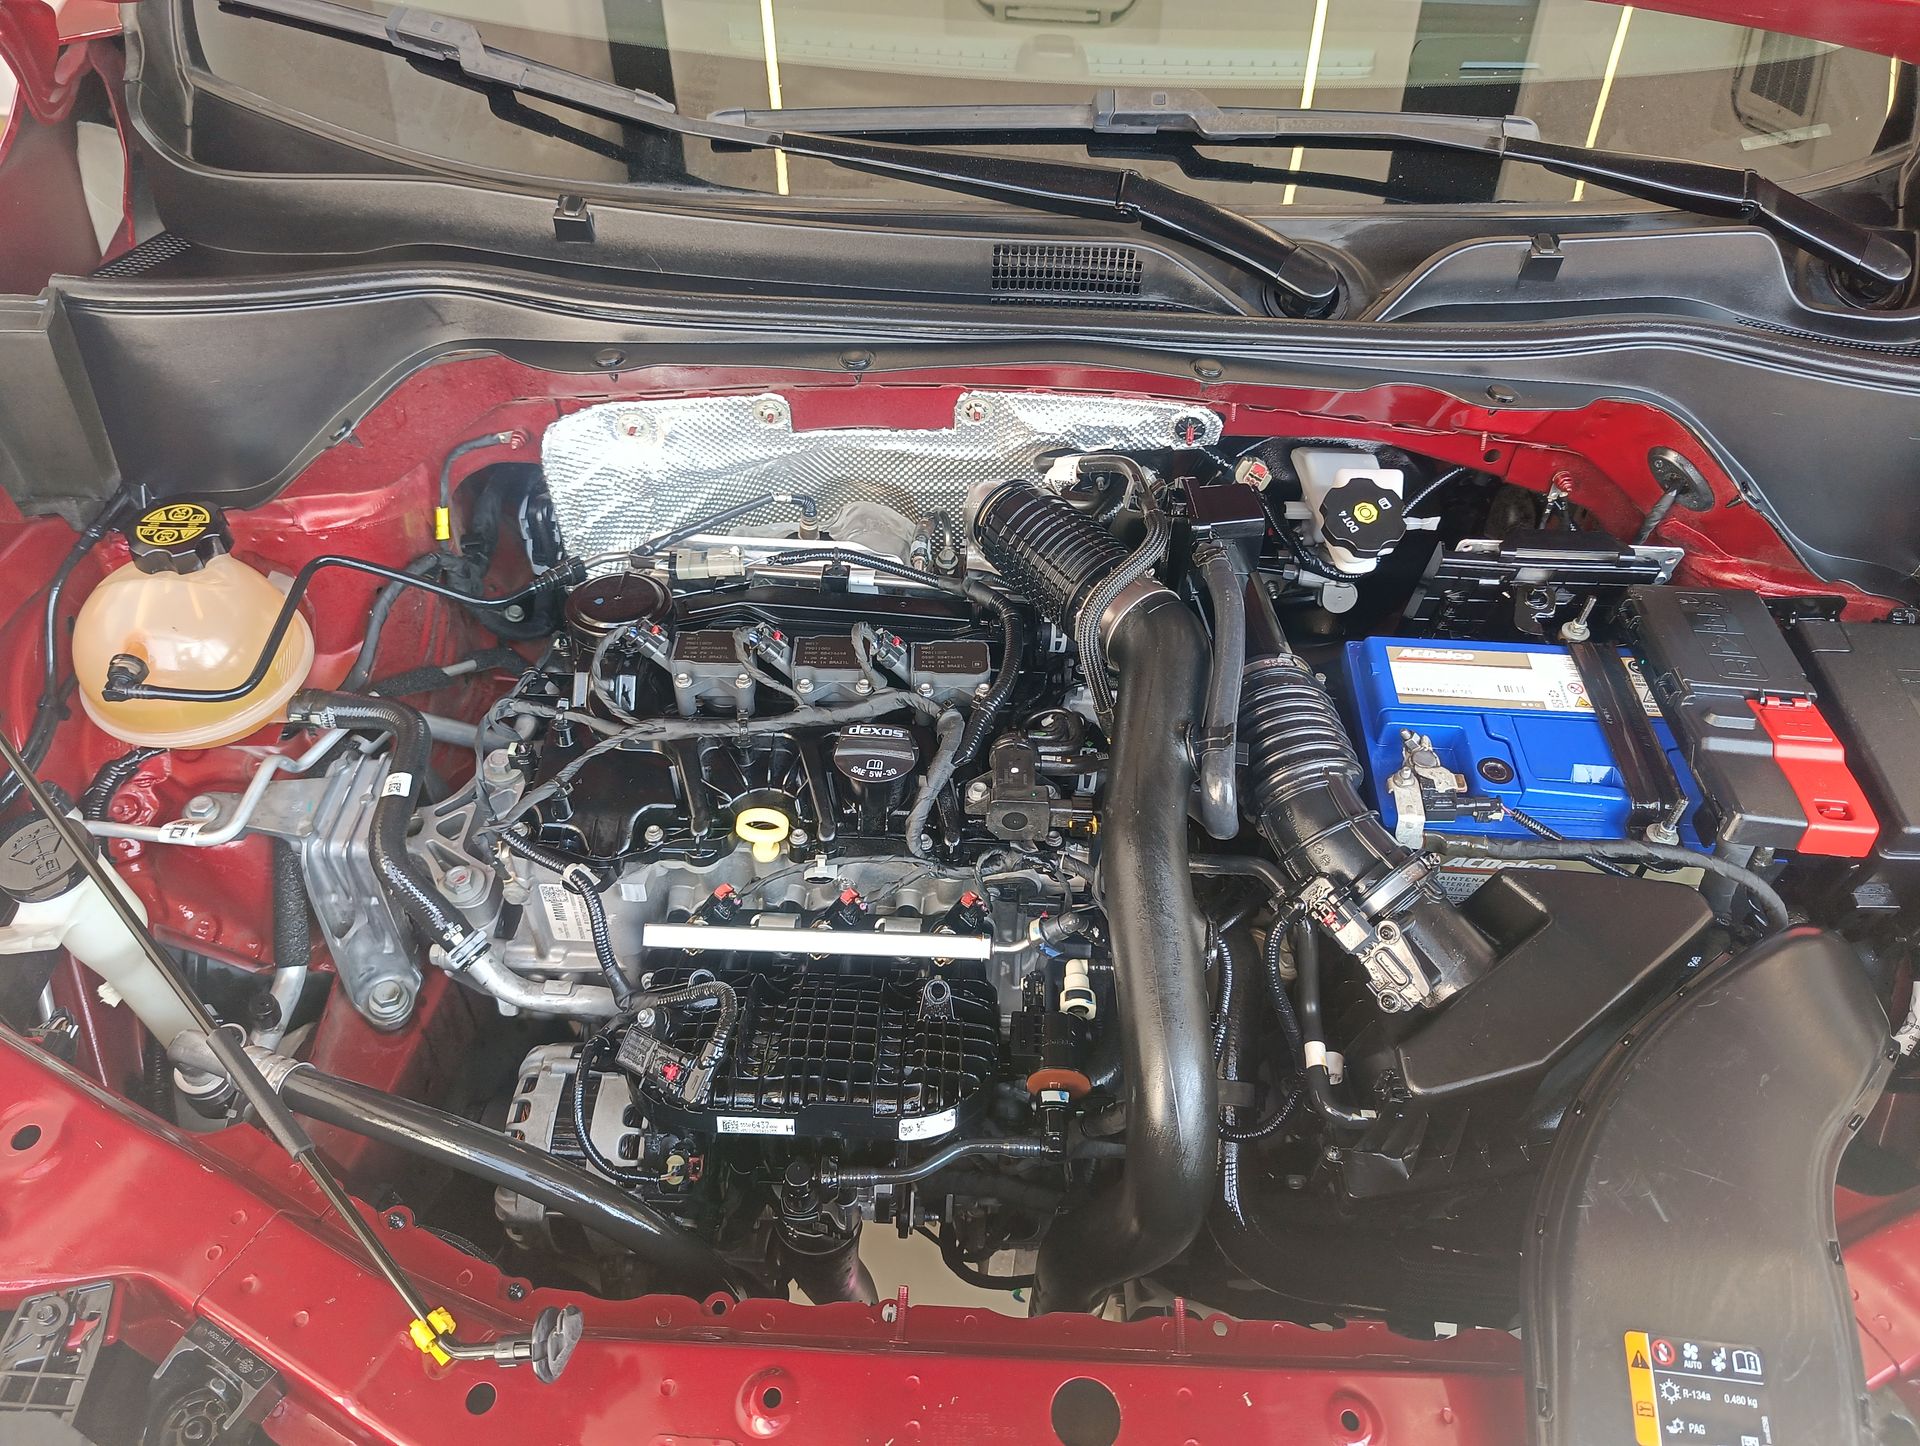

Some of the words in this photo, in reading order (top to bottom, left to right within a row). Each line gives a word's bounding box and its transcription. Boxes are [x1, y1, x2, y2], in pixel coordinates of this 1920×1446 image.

[1342, 516, 1360, 534] DOT
[848, 725, 904, 738] dexos
[850, 766, 866, 776] SAE
[868, 768, 897, 778] 5W-30
[786, 1124, 794, 1132] H
[1684, 1360, 1702, 1369] AUTO
[1682, 1388, 1711, 1401] R-134a
[1724, 1394, 1746, 1405] 0.480
[1747, 1396, 1758, 1409] kg
[1688, 1423, 1706, 1435] PAG
